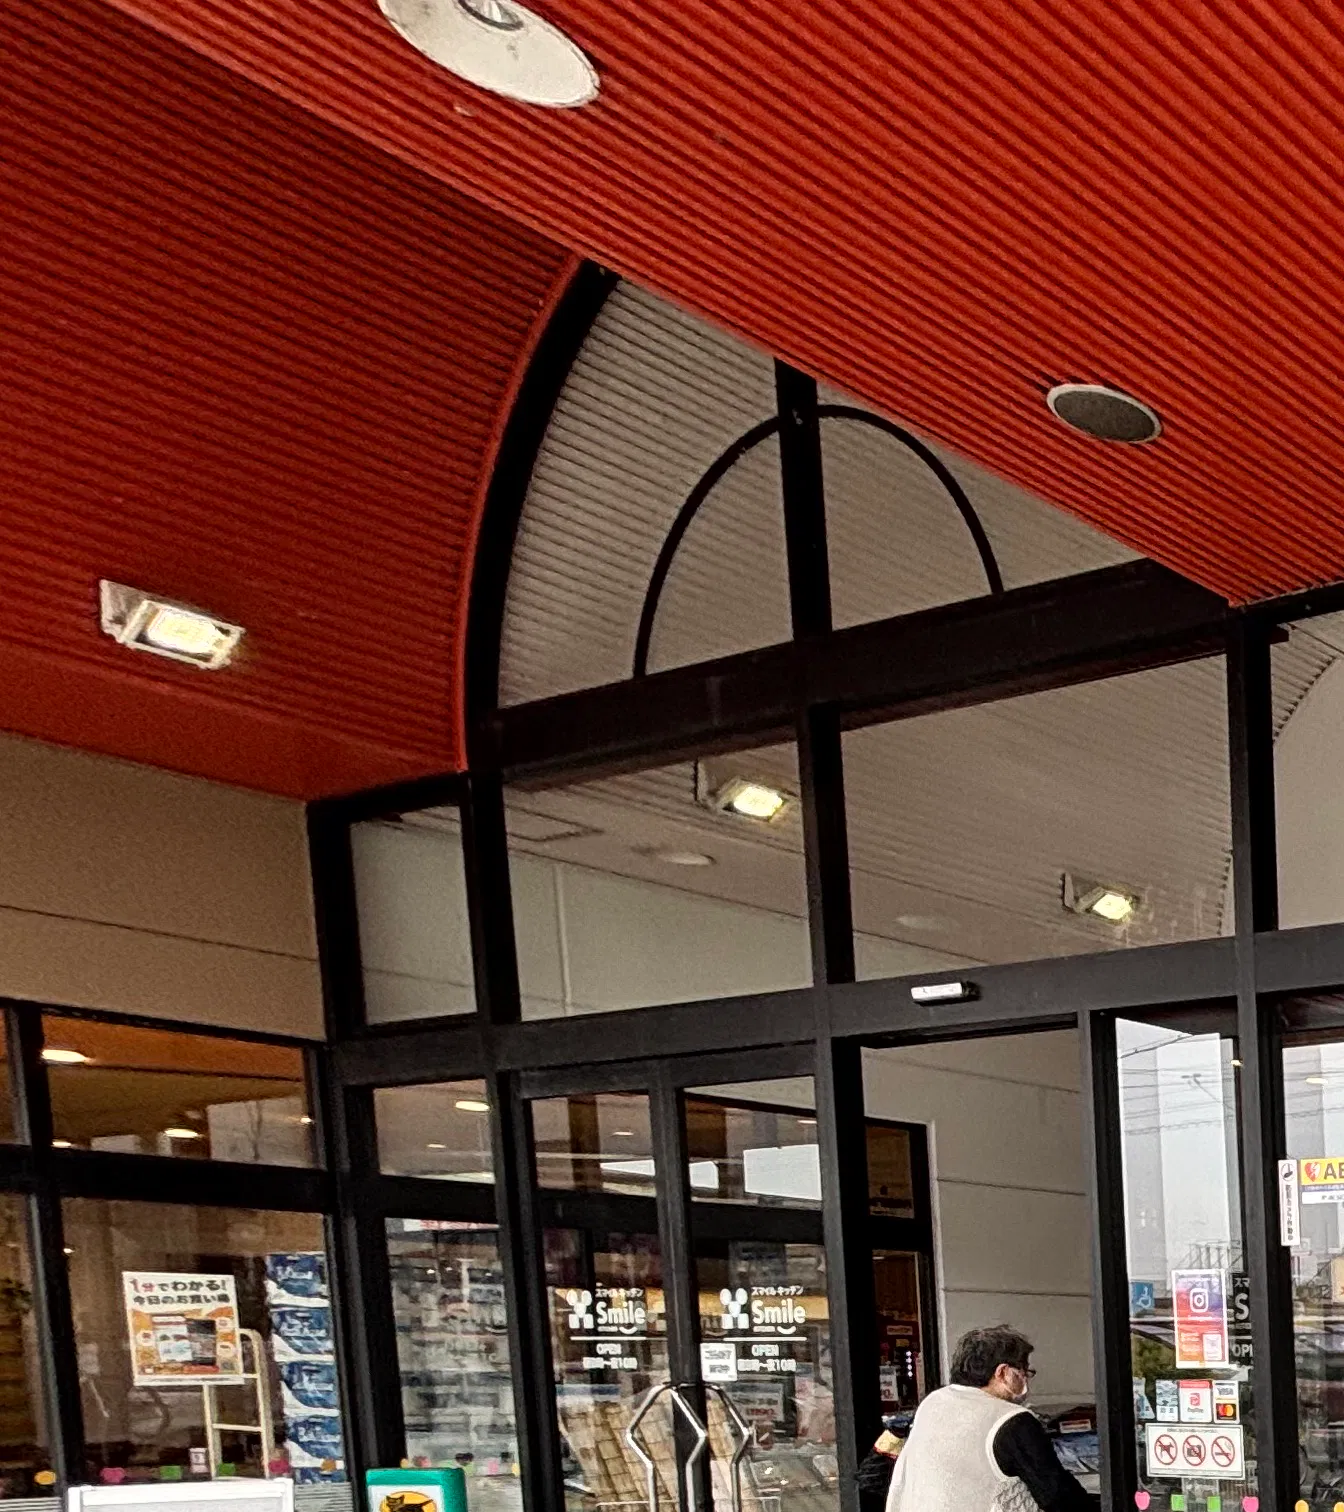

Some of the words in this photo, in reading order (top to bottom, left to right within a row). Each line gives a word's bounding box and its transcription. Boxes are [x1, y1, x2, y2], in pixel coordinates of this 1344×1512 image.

[596, 1300, 646, 1324] Smile
[751, 1297, 806, 1324] Smile
[596, 1343, 622, 1355] OPEN
[751, 1344, 780, 1356] OPEN
